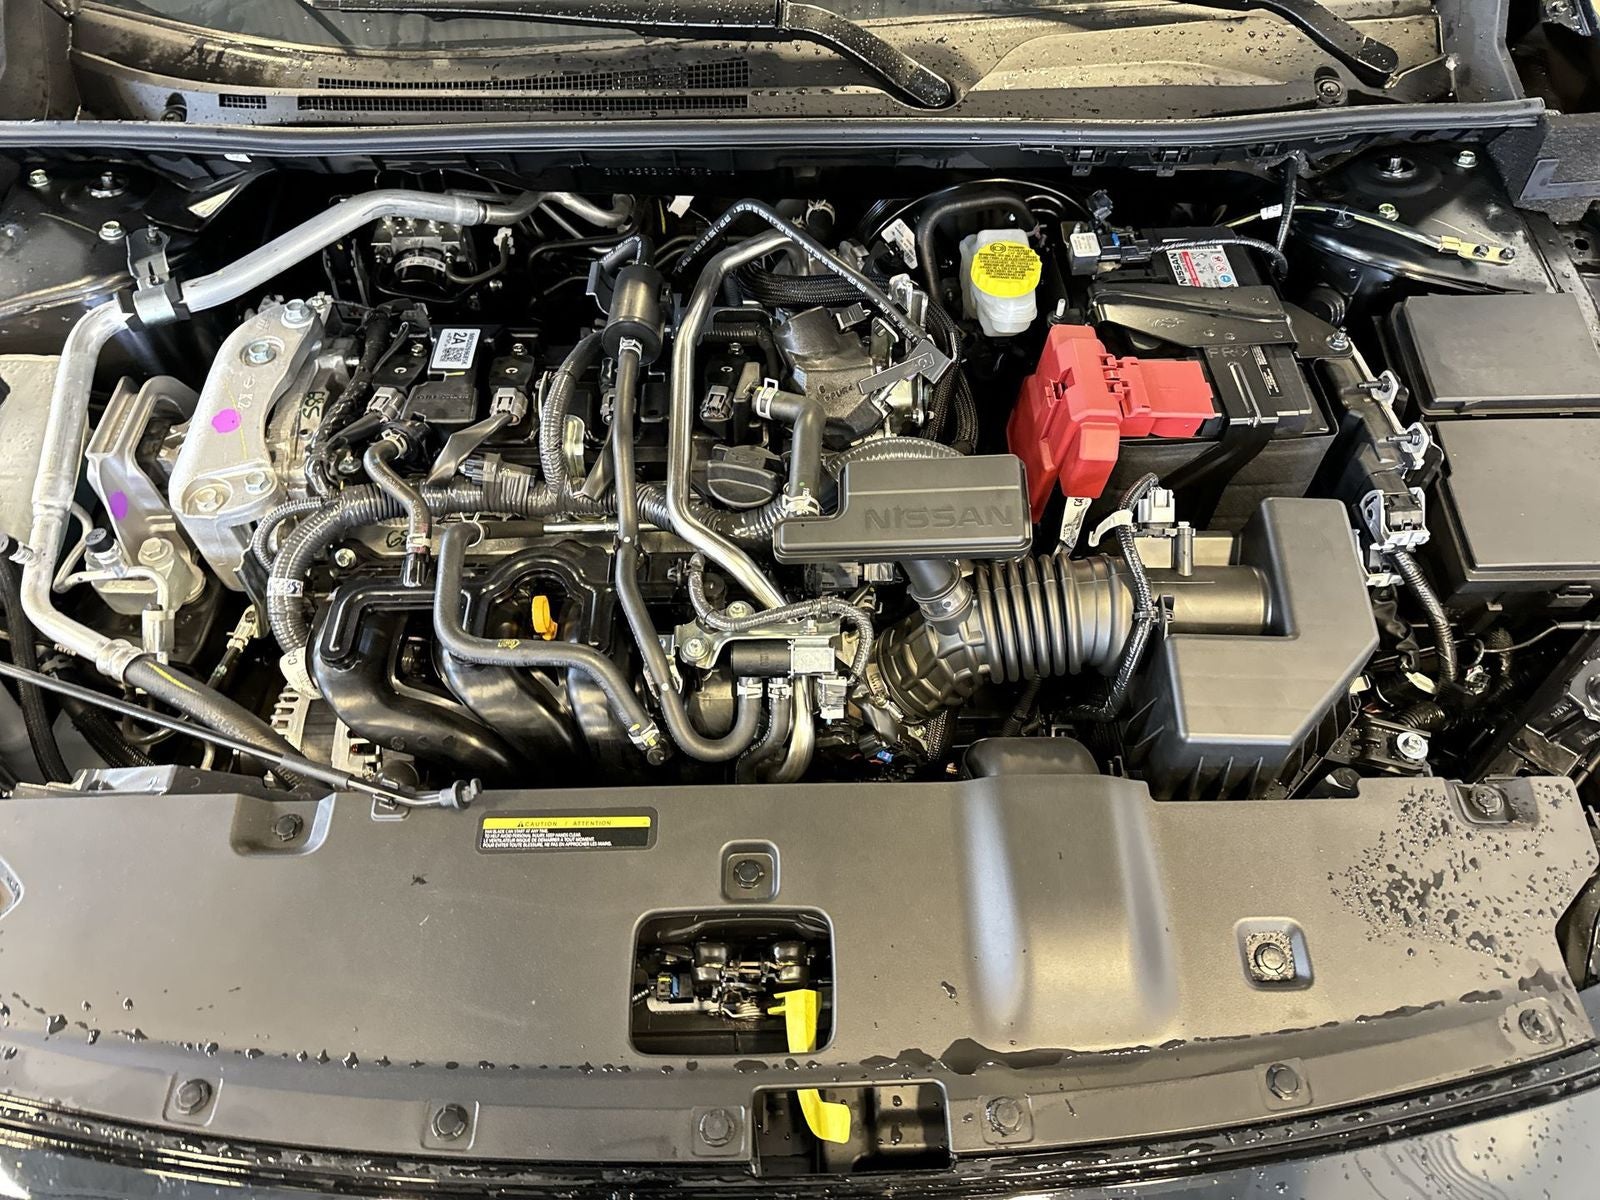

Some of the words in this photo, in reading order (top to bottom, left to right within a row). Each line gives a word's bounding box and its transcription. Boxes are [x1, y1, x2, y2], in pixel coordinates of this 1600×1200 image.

[1170, 253, 1188, 286] NISSAN
[451, 332, 468, 345] 2A
[863, 505, 1014, 530] NISSAN
